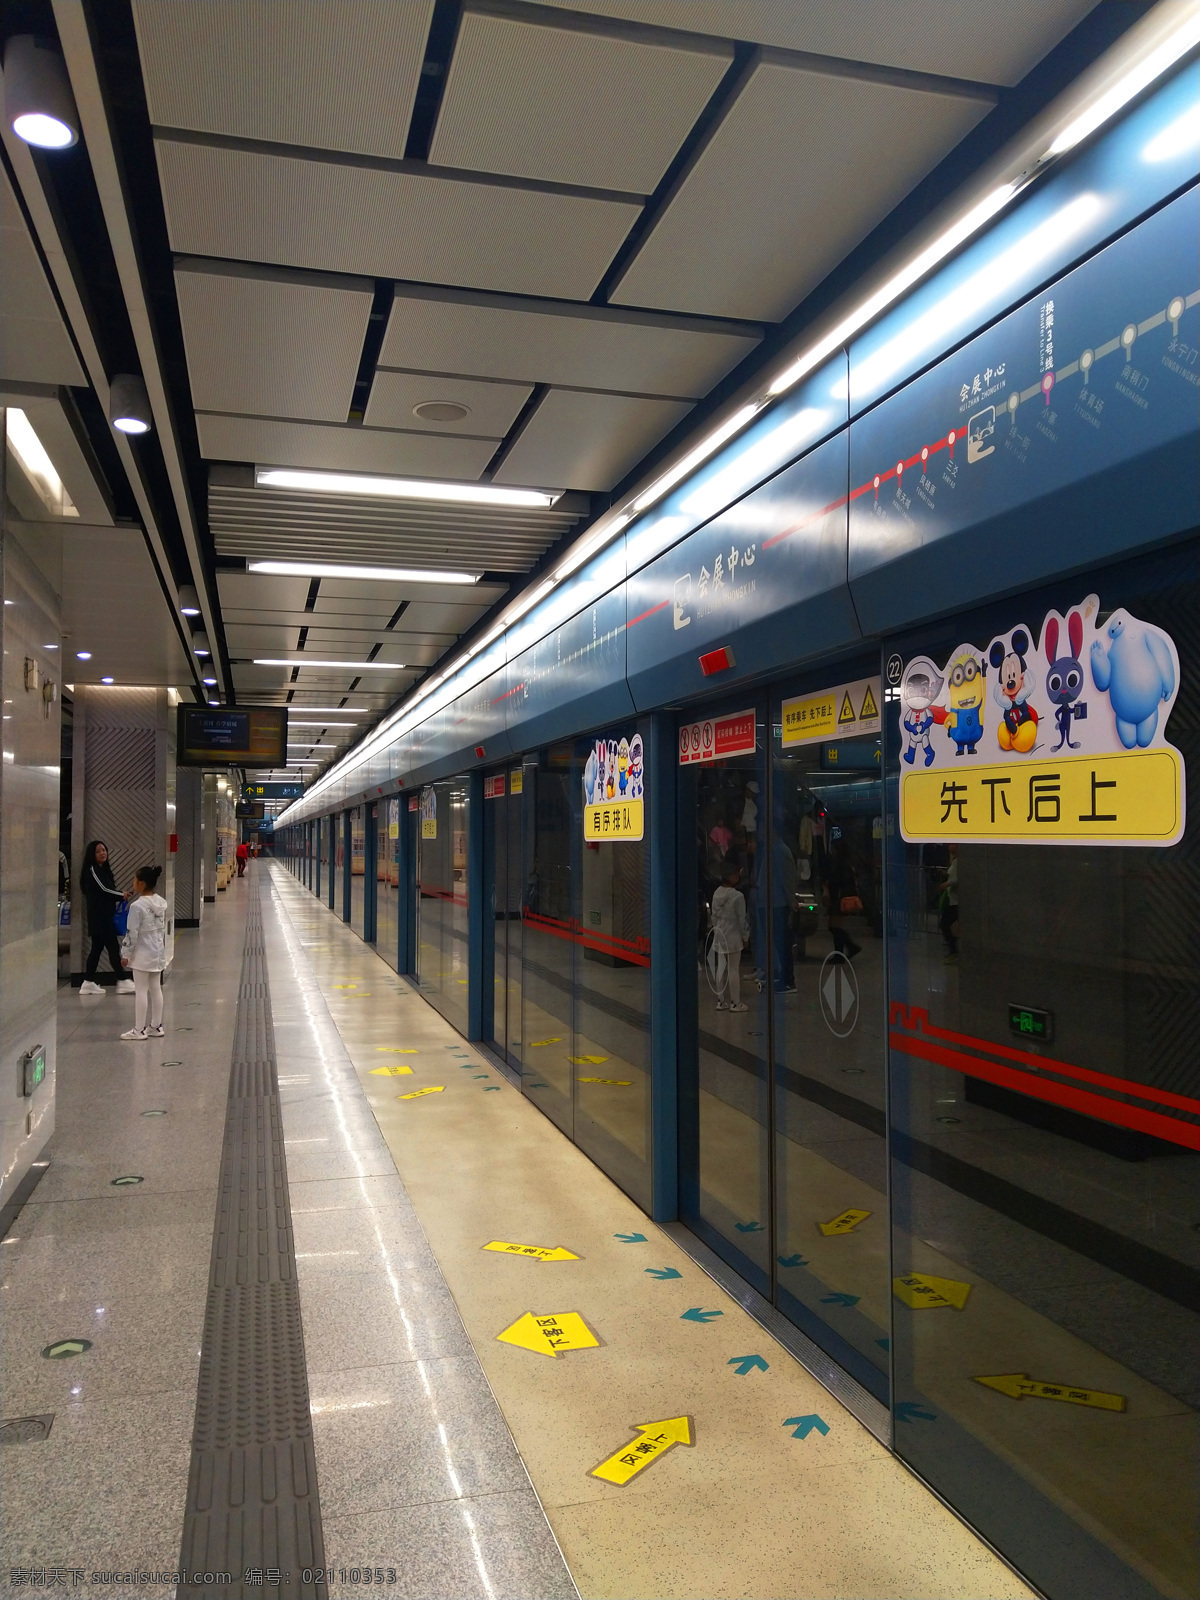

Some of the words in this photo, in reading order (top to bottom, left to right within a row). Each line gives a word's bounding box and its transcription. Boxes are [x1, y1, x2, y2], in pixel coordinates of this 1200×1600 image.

[1167, 338, 1199, 365] 永宁门
[959, 397, 980, 412] HUIZHAN
[981, 380, 1006, 401] ZHONGXIN
[960, 362, 1006, 402] 会展中心
[698, 544, 756, 599] 会展中心
[889, 661, 900, 678] 22
[809, 704, 832, 720] 先下后上
[941, 771, 1117, 823] 先下后上
[593, 808, 631, 832] 有序排队
[536, 1317, 570, 1348] 下客区
[619, 1433, 668, 1466] 上客区
